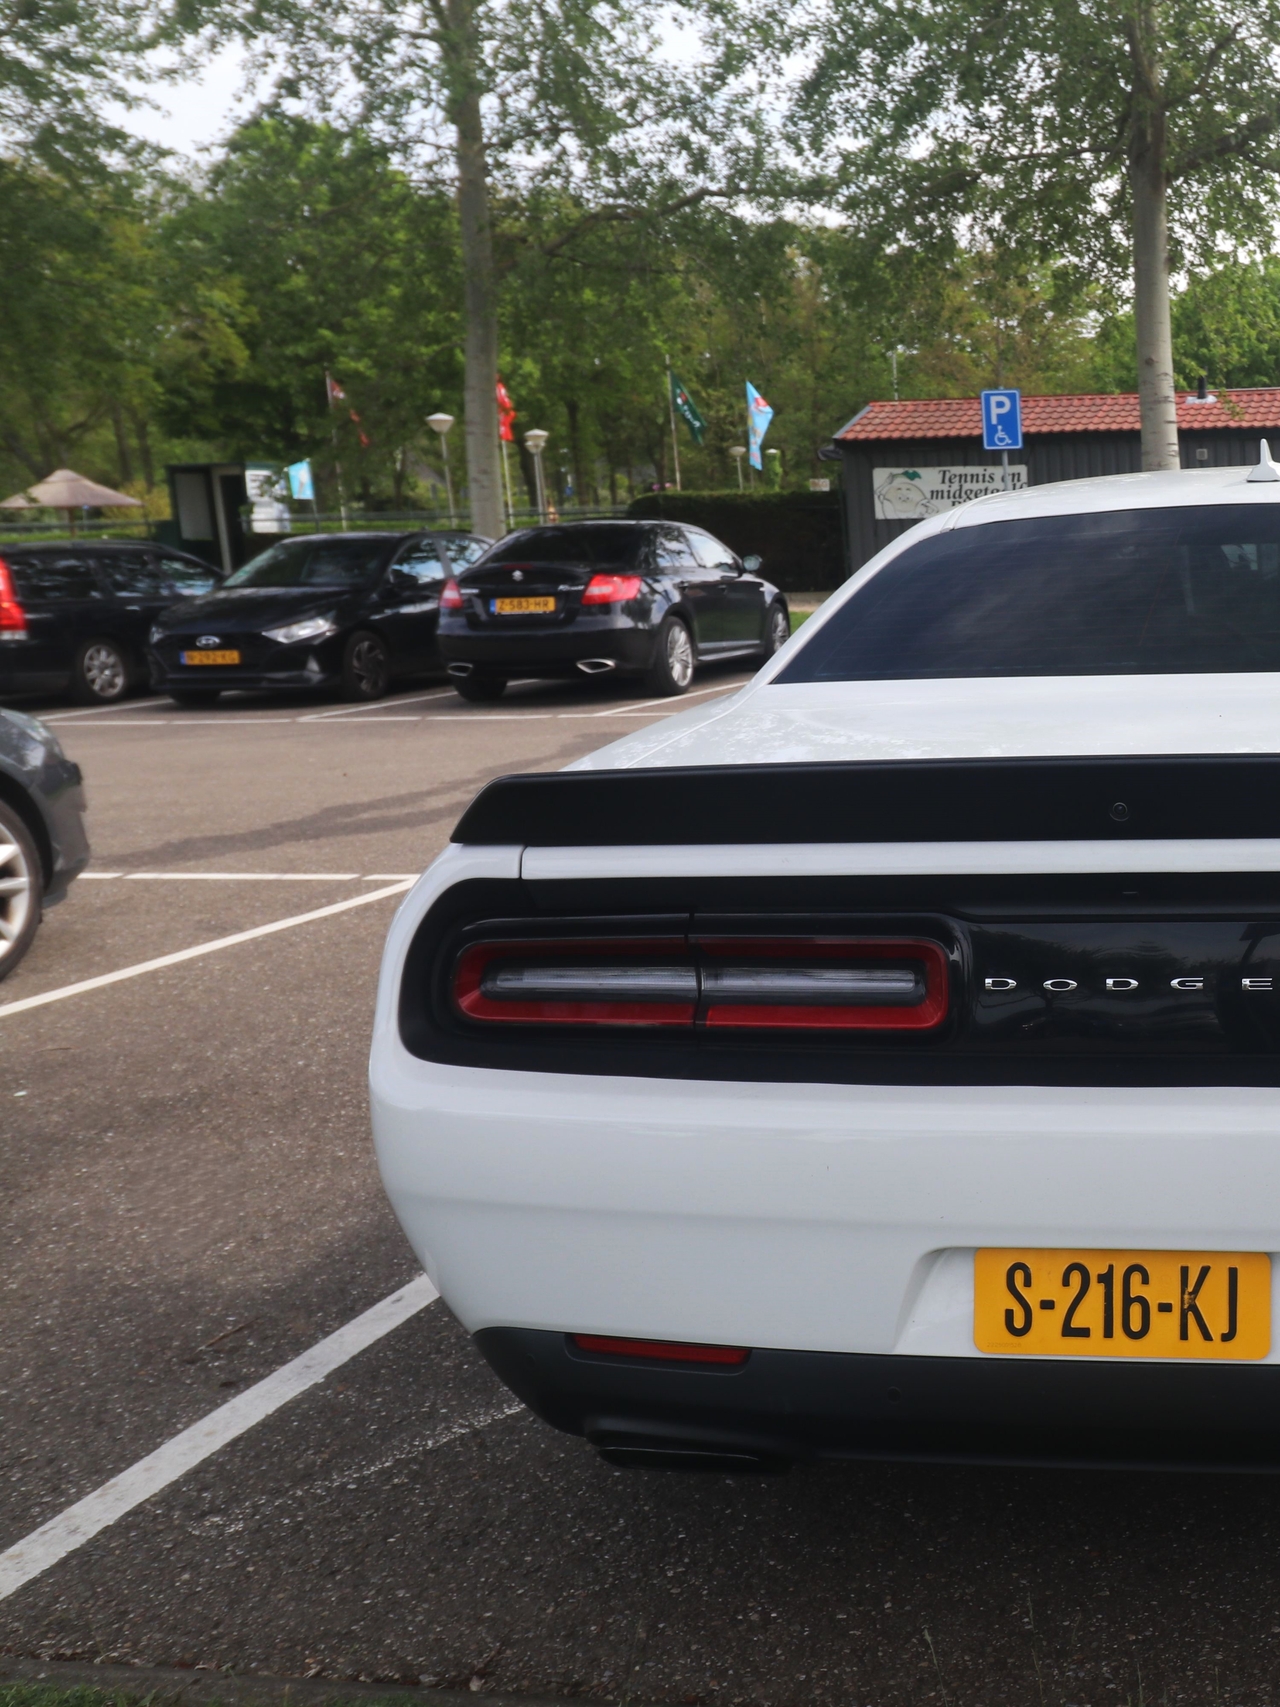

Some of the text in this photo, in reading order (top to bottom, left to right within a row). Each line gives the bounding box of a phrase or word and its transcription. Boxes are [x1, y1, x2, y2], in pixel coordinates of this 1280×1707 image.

[990, 395, 1011, 425] P
[938, 468, 995, 484] Tennis
[984, 977, 1273, 991] DODGE
[1004, 1261, 1239, 1343] S-216-KJ
